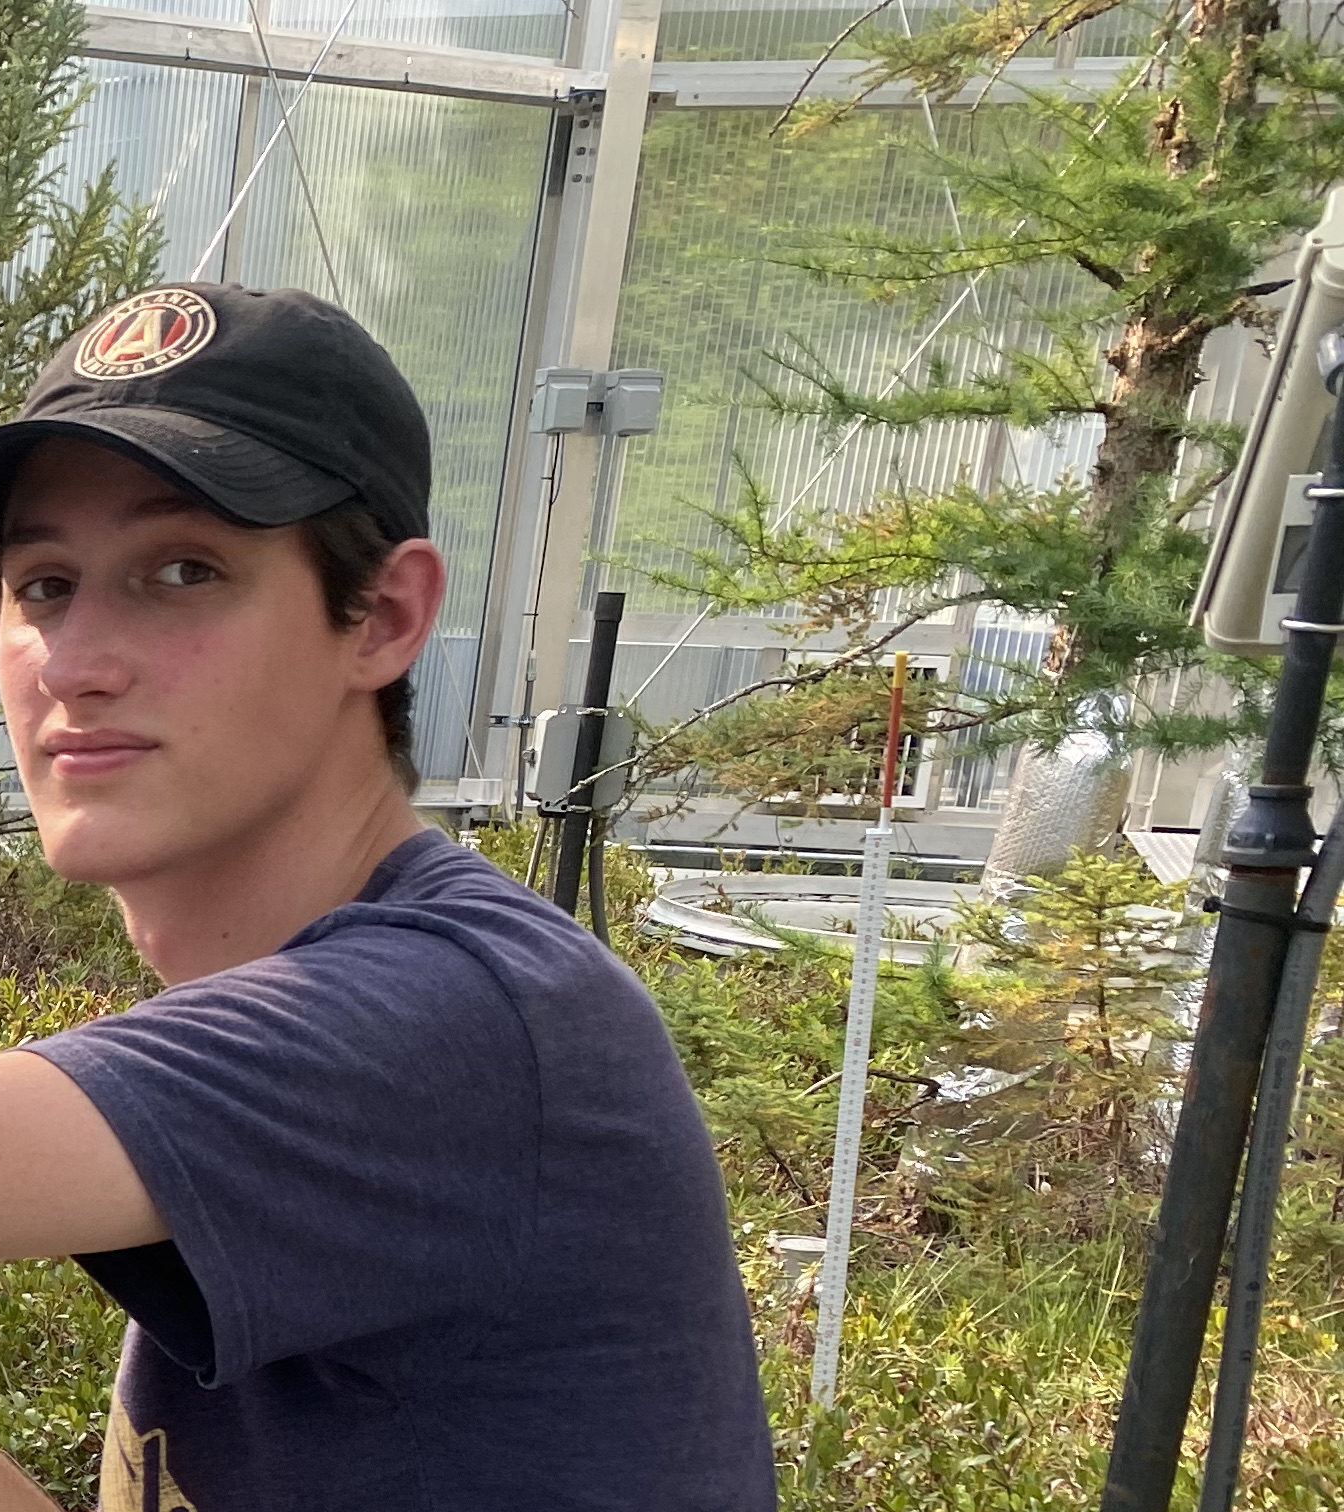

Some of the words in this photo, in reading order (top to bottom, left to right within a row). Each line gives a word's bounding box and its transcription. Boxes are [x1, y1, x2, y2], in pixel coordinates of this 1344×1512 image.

[113, 292, 204, 324] ATLANTA
[81, 355, 146, 376] UNITED
[153, 348, 183, 366] FC
